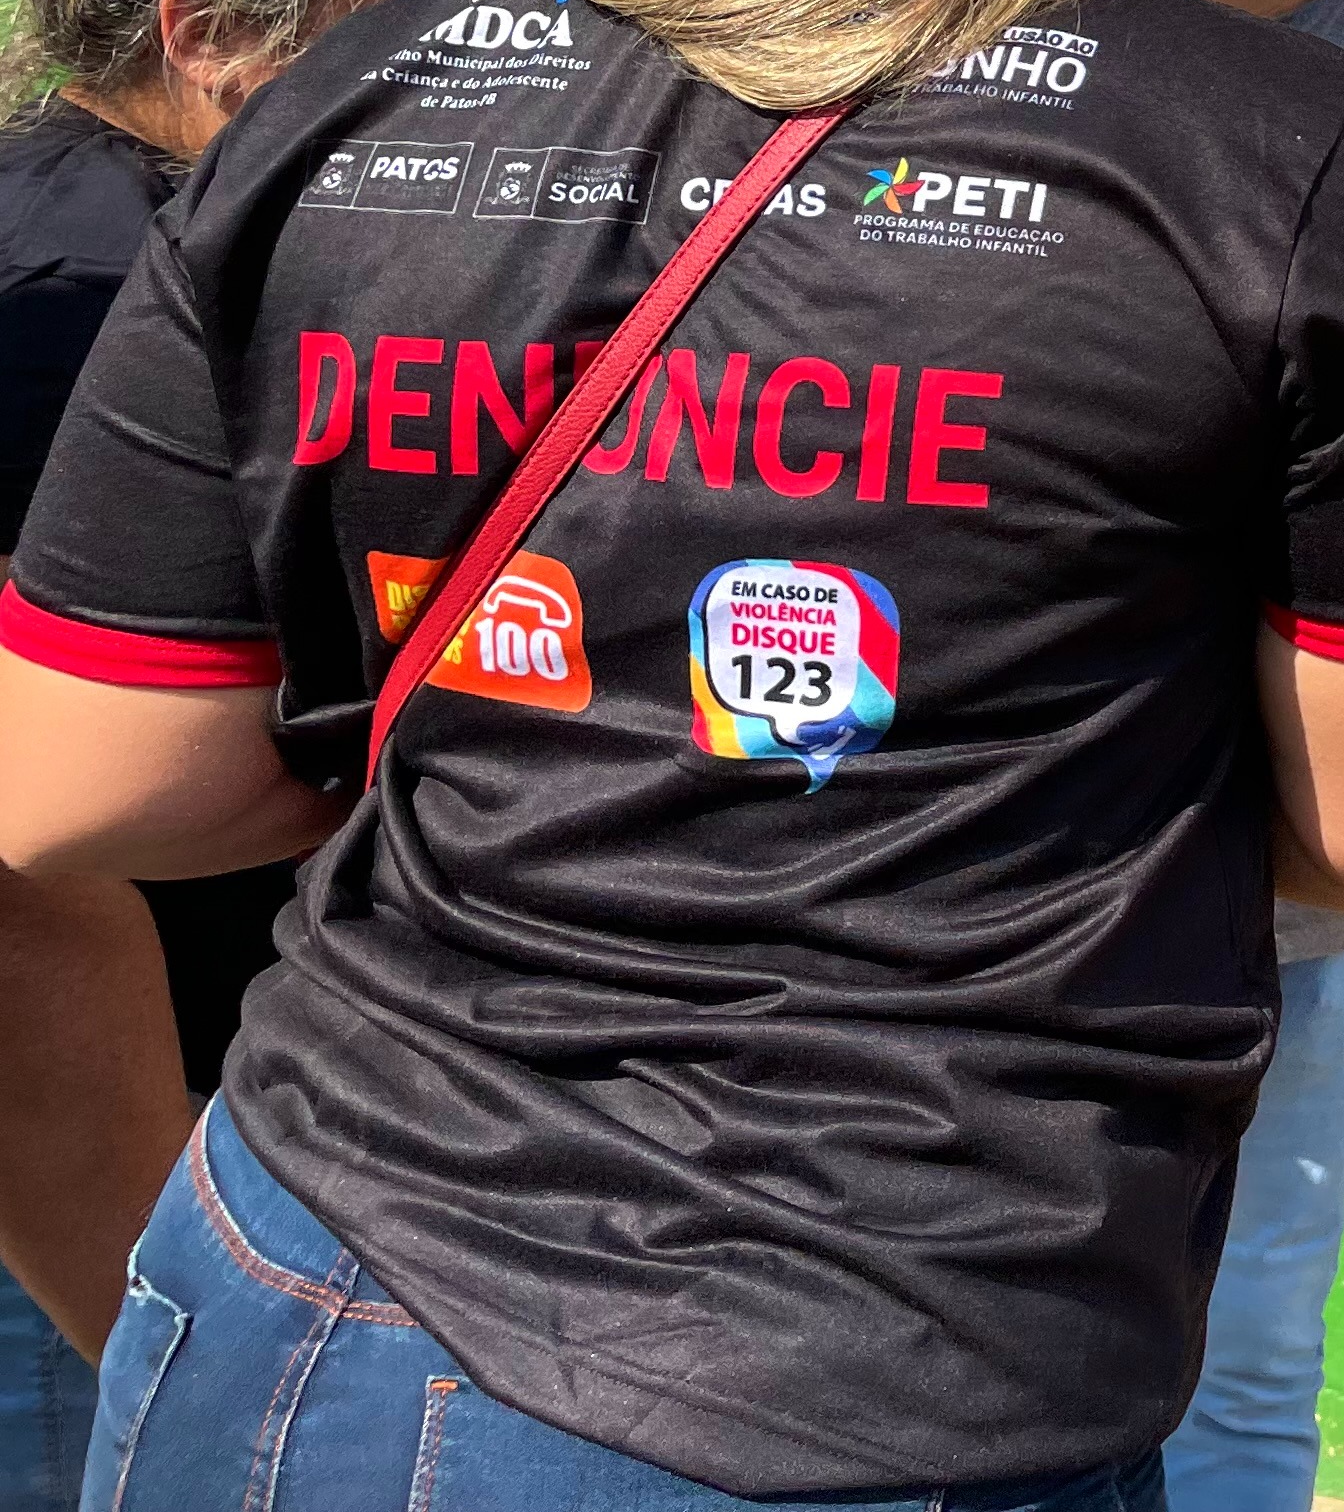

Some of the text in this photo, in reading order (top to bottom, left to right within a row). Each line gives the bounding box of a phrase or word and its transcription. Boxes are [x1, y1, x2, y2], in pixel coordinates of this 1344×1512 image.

[1064, 38, 1095, 55] AO
[426, 49, 504, 73] Municipal
[505, 56, 529, 70] dos
[528, 53, 592, 71] Direitos
[382, 67, 449, 90] Criança
[451, 78, 461, 89] e
[462, 76, 481, 90] do
[482, 74, 569, 92] Adolescente
[420, 95, 439, 109] de
[1001, 92, 1076, 111] INFANTIL
[369, 155, 461, 181] PATOS
[548, 181, 640, 205] SOCIAL
[680, 176, 827, 217] CAS
[912, 171, 1048, 224] PETI
[853, 213, 945, 232] PROGRAMA
[949, 222, 971, 234] DE
[859, 228, 1049, 258] DO TRABALHO INFANTIL
[731, 580, 839, 604] EM CASO DE
[730, 601, 837, 626] VIOLÊNCIA
[475, 617, 569, 681] 100
[731, 622, 836, 656] DISQUE
[731, 654, 833, 707] 123
